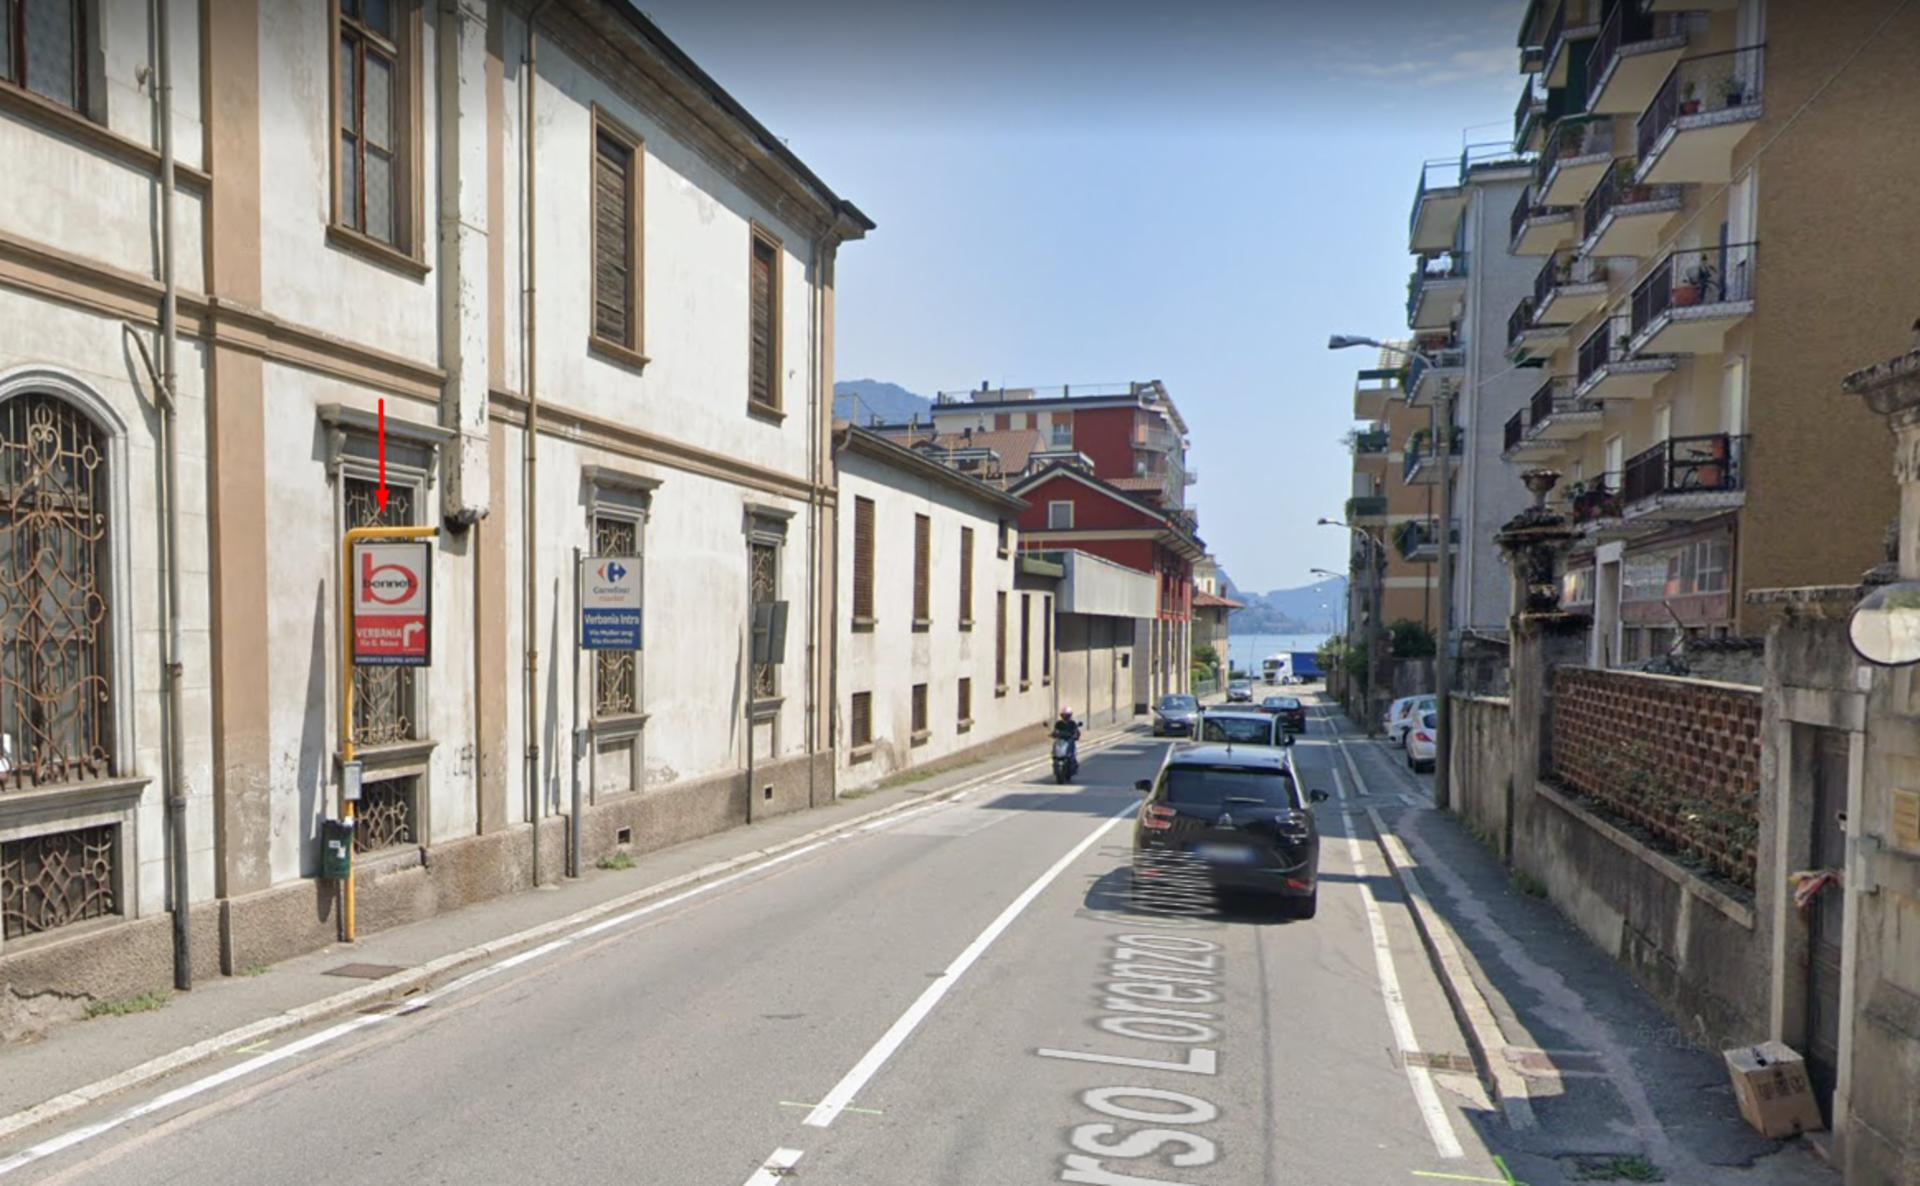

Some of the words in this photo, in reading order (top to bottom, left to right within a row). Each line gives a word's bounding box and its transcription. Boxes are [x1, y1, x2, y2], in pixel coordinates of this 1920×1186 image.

[592, 586, 631, 594] Carrefour
[585, 614, 619, 625] Verbania
[620, 614, 640, 625] Intra
[356, 627, 402, 638] VERBANIA
